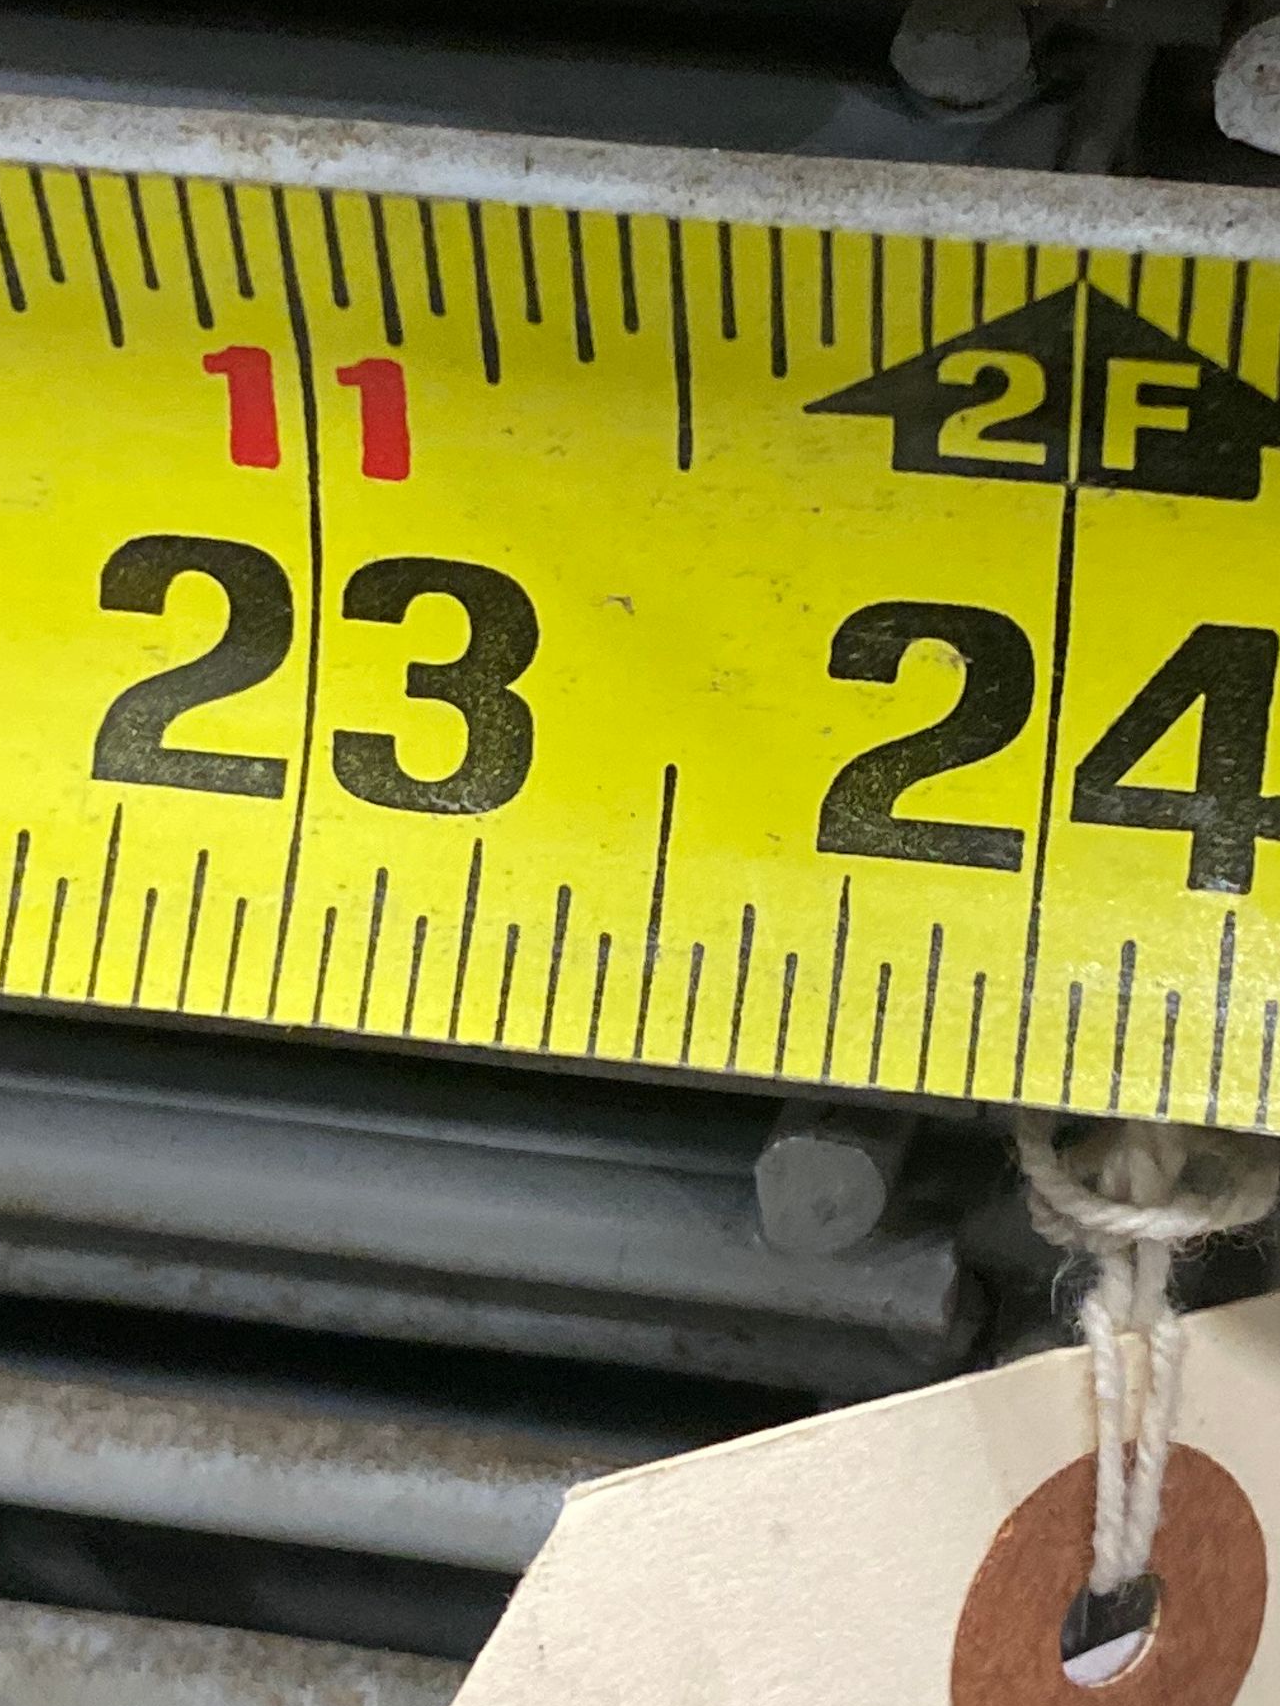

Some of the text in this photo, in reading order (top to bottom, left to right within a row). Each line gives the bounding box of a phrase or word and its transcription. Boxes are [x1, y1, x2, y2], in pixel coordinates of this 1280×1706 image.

[204, 345, 410, 480] 11
[936, 350, 1206, 472] 2F
[92, 534, 539, 814] 23
